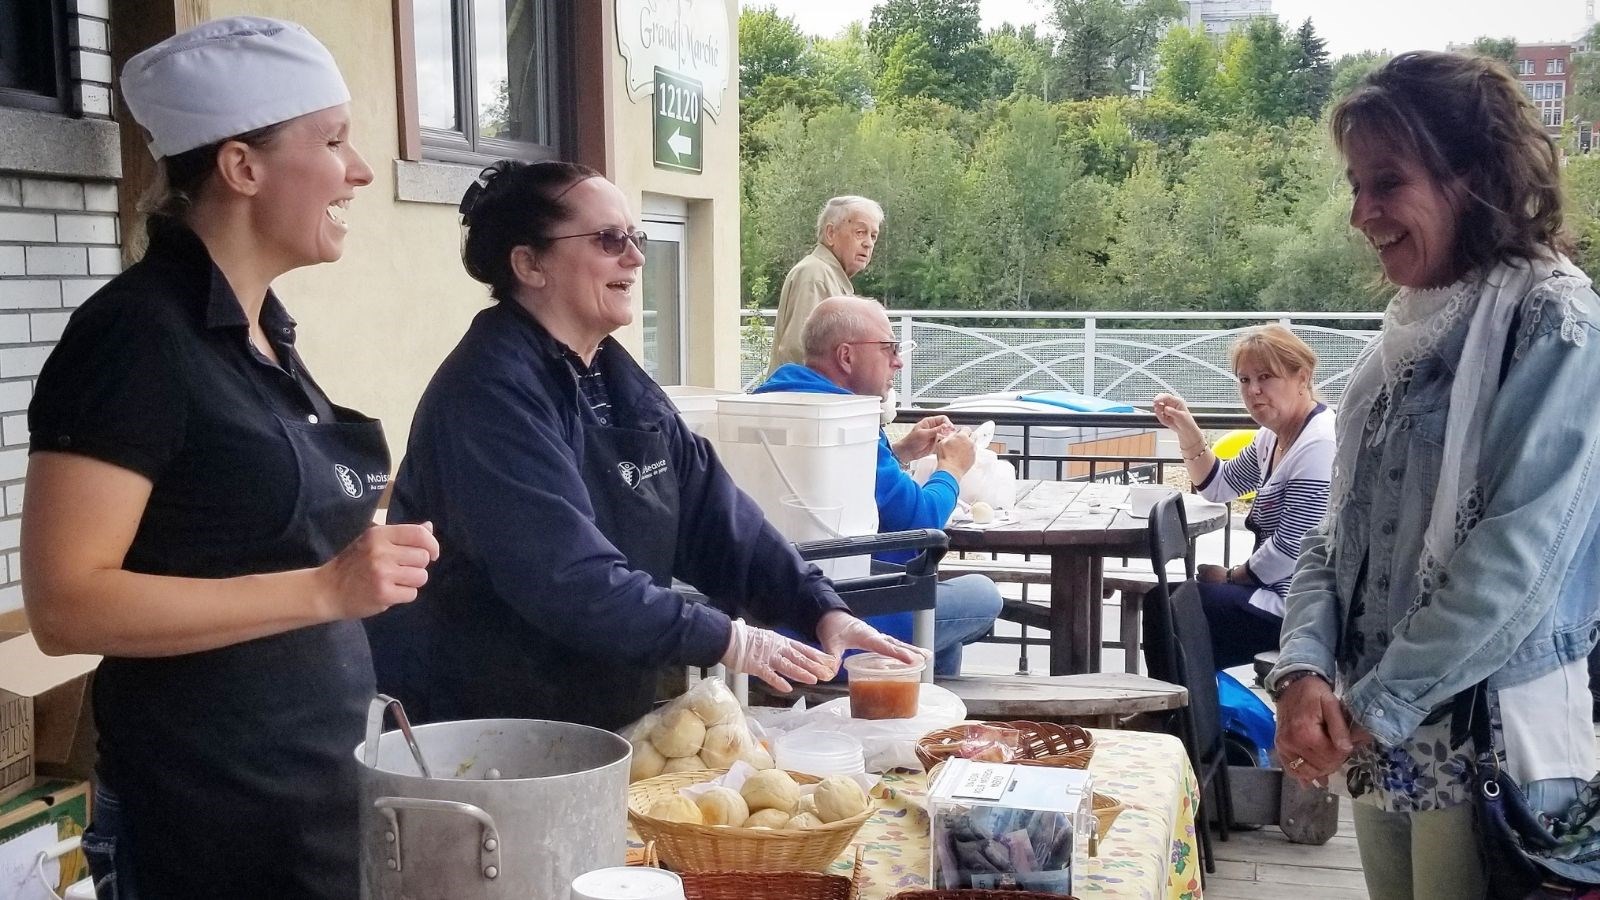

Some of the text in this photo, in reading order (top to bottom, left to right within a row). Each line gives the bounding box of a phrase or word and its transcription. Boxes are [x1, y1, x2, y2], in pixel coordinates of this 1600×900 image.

[640, 7, 719, 70] Grand Marché
[659, 82, 699, 125] 12120
